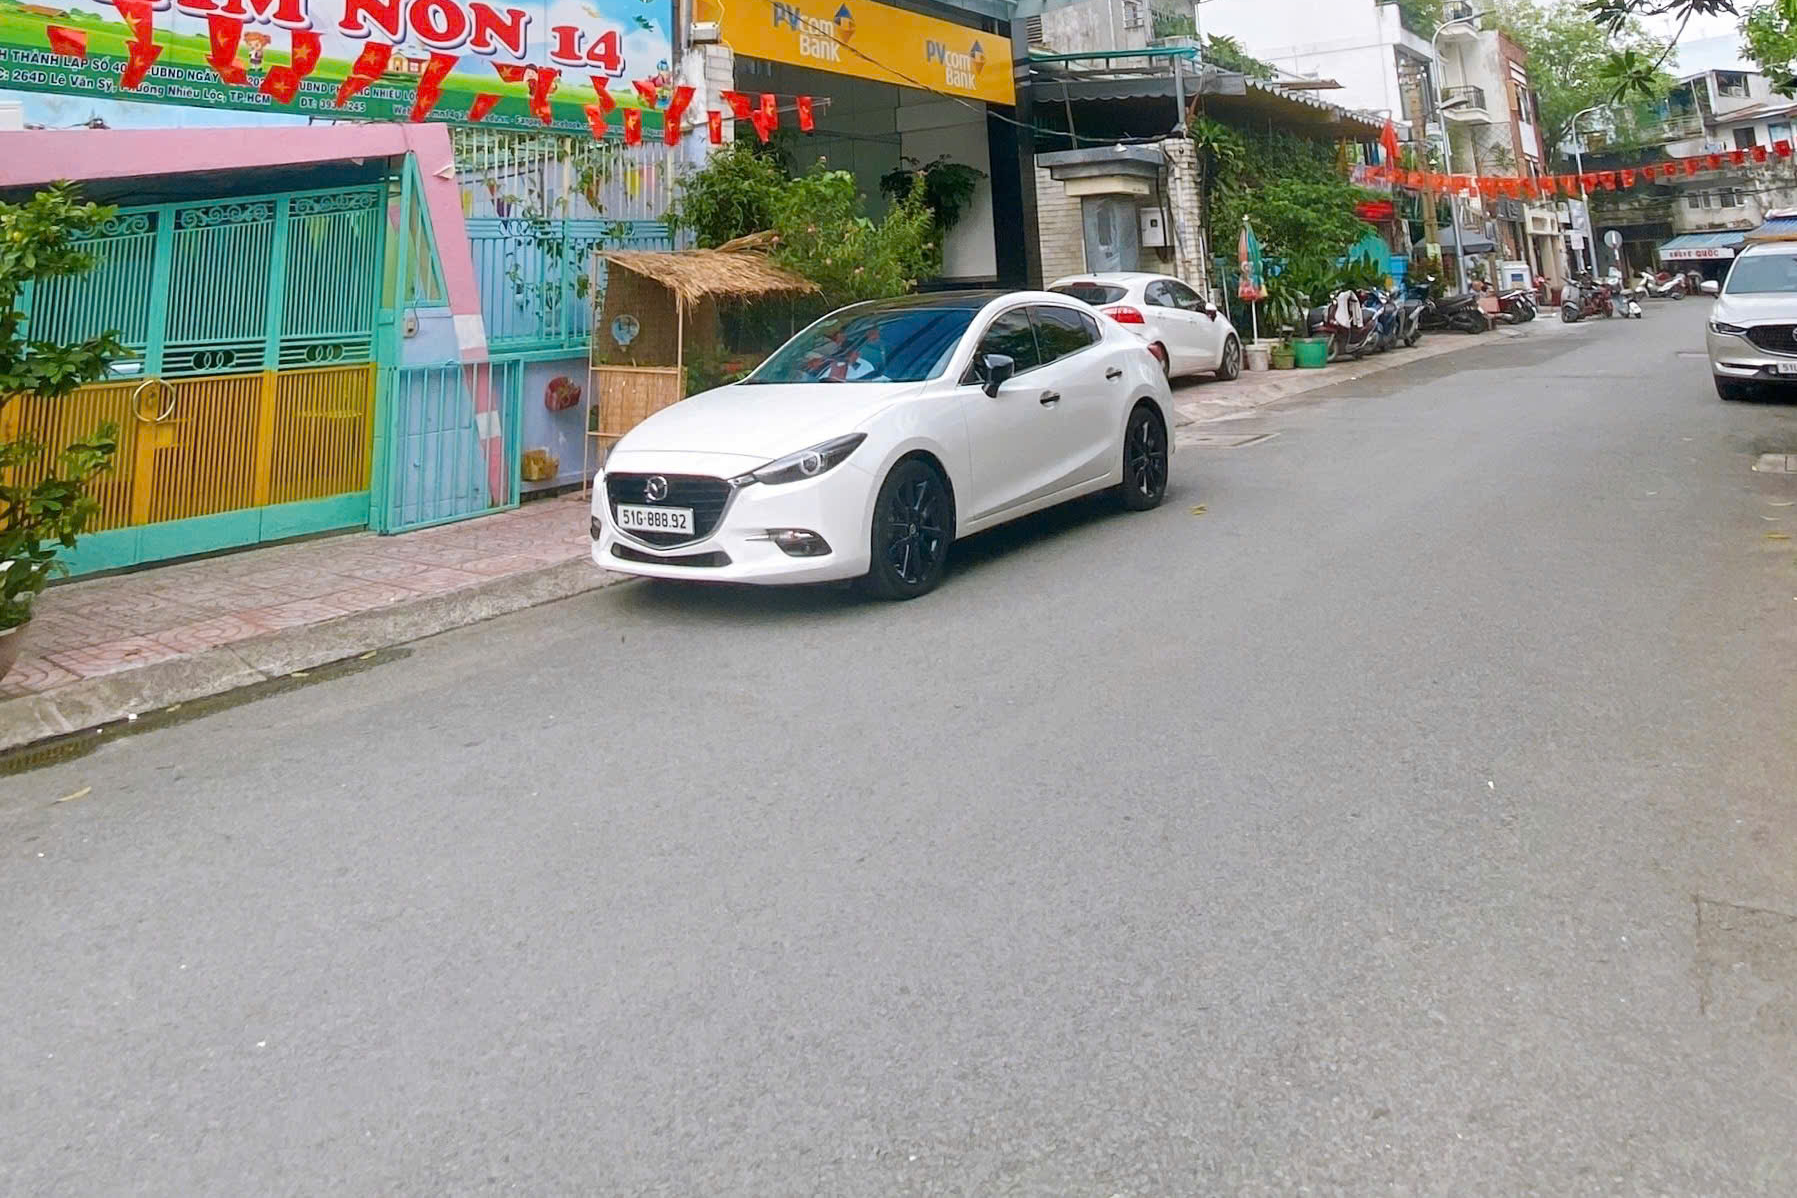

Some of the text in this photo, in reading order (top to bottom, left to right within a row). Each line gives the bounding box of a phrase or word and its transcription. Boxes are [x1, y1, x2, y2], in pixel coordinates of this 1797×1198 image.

[773, 1, 834, 37] PVcom
[551, 25, 622, 72] 14
[800, 33, 841, 63] Bank
[926, 40, 971, 71] PVcom
[12, 49, 60, 66] THÀNH
[92, 56, 112, 71] SỐ
[188, 68, 219, 83] NGÀY
[13, 70, 47, 83] 264D
[51, 72, 66, 85] Lê
[70, 75, 94, 88] Văn
[945, 66, 977, 91] Bank
[299, 81, 327, 93] UBND
